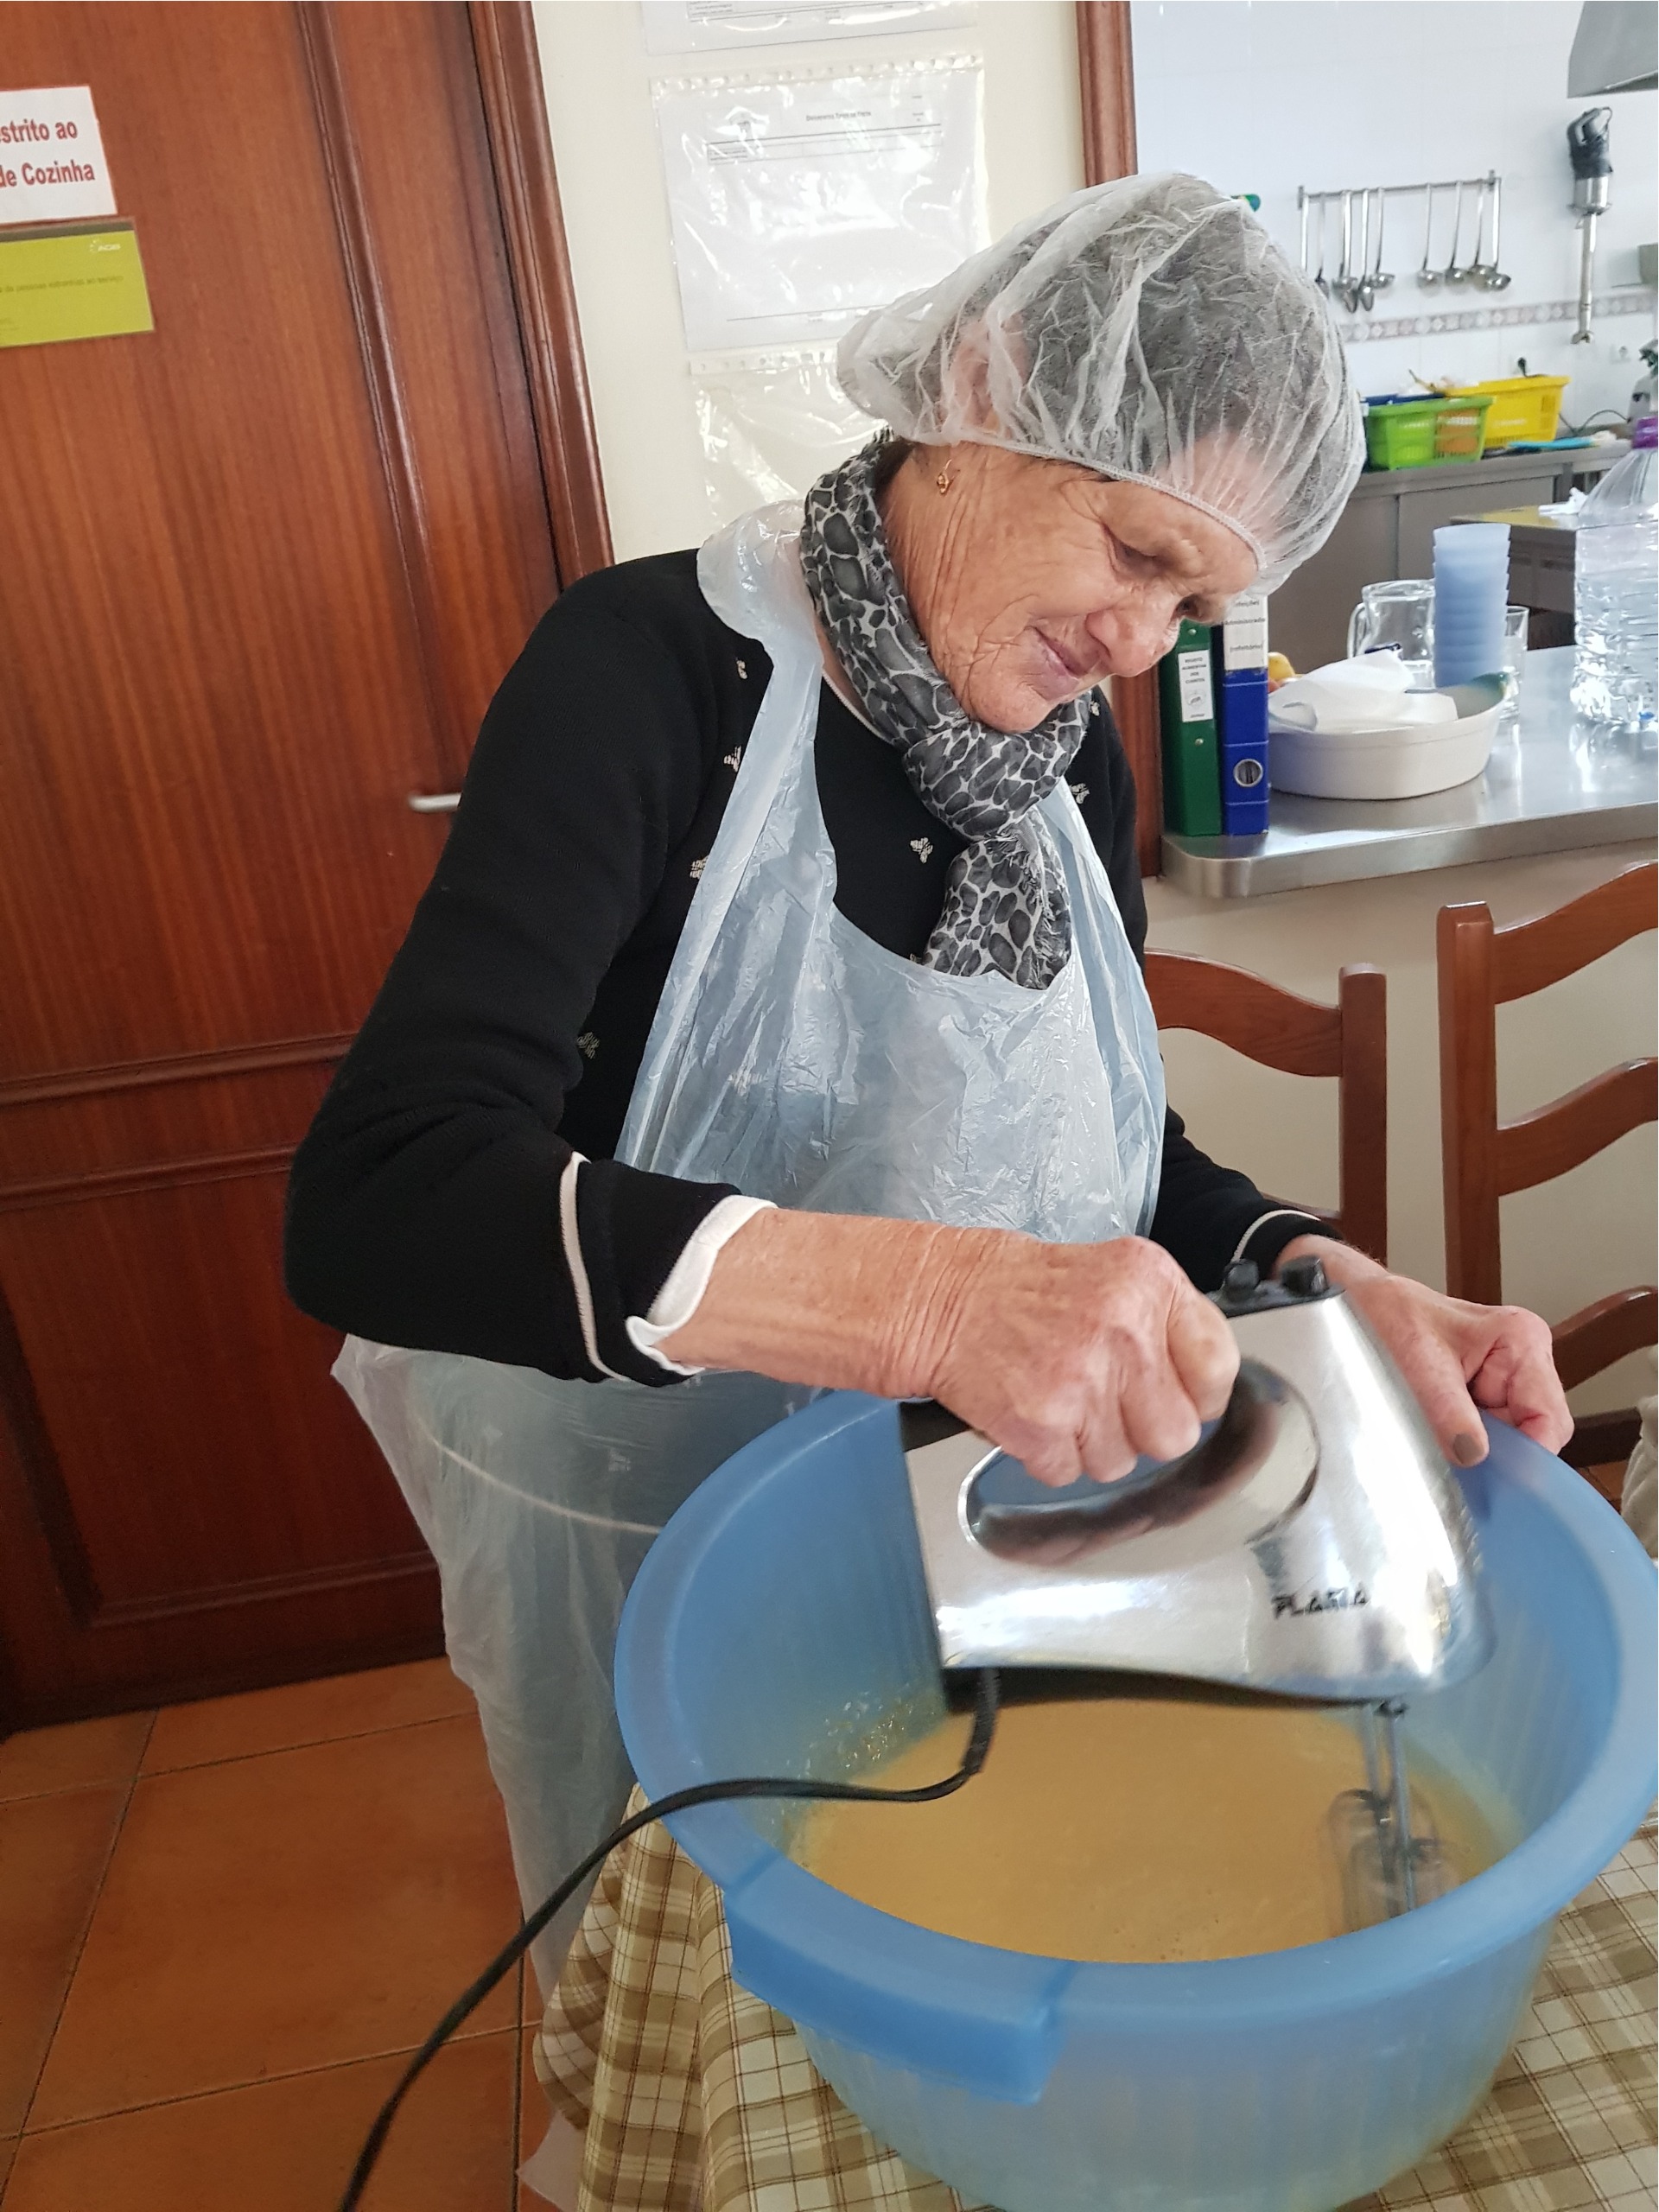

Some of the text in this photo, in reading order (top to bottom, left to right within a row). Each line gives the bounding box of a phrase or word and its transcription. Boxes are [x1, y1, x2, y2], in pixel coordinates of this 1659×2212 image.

[0, 118, 78, 143] strito ao
[22, 159, 95, 185] Cozinha
